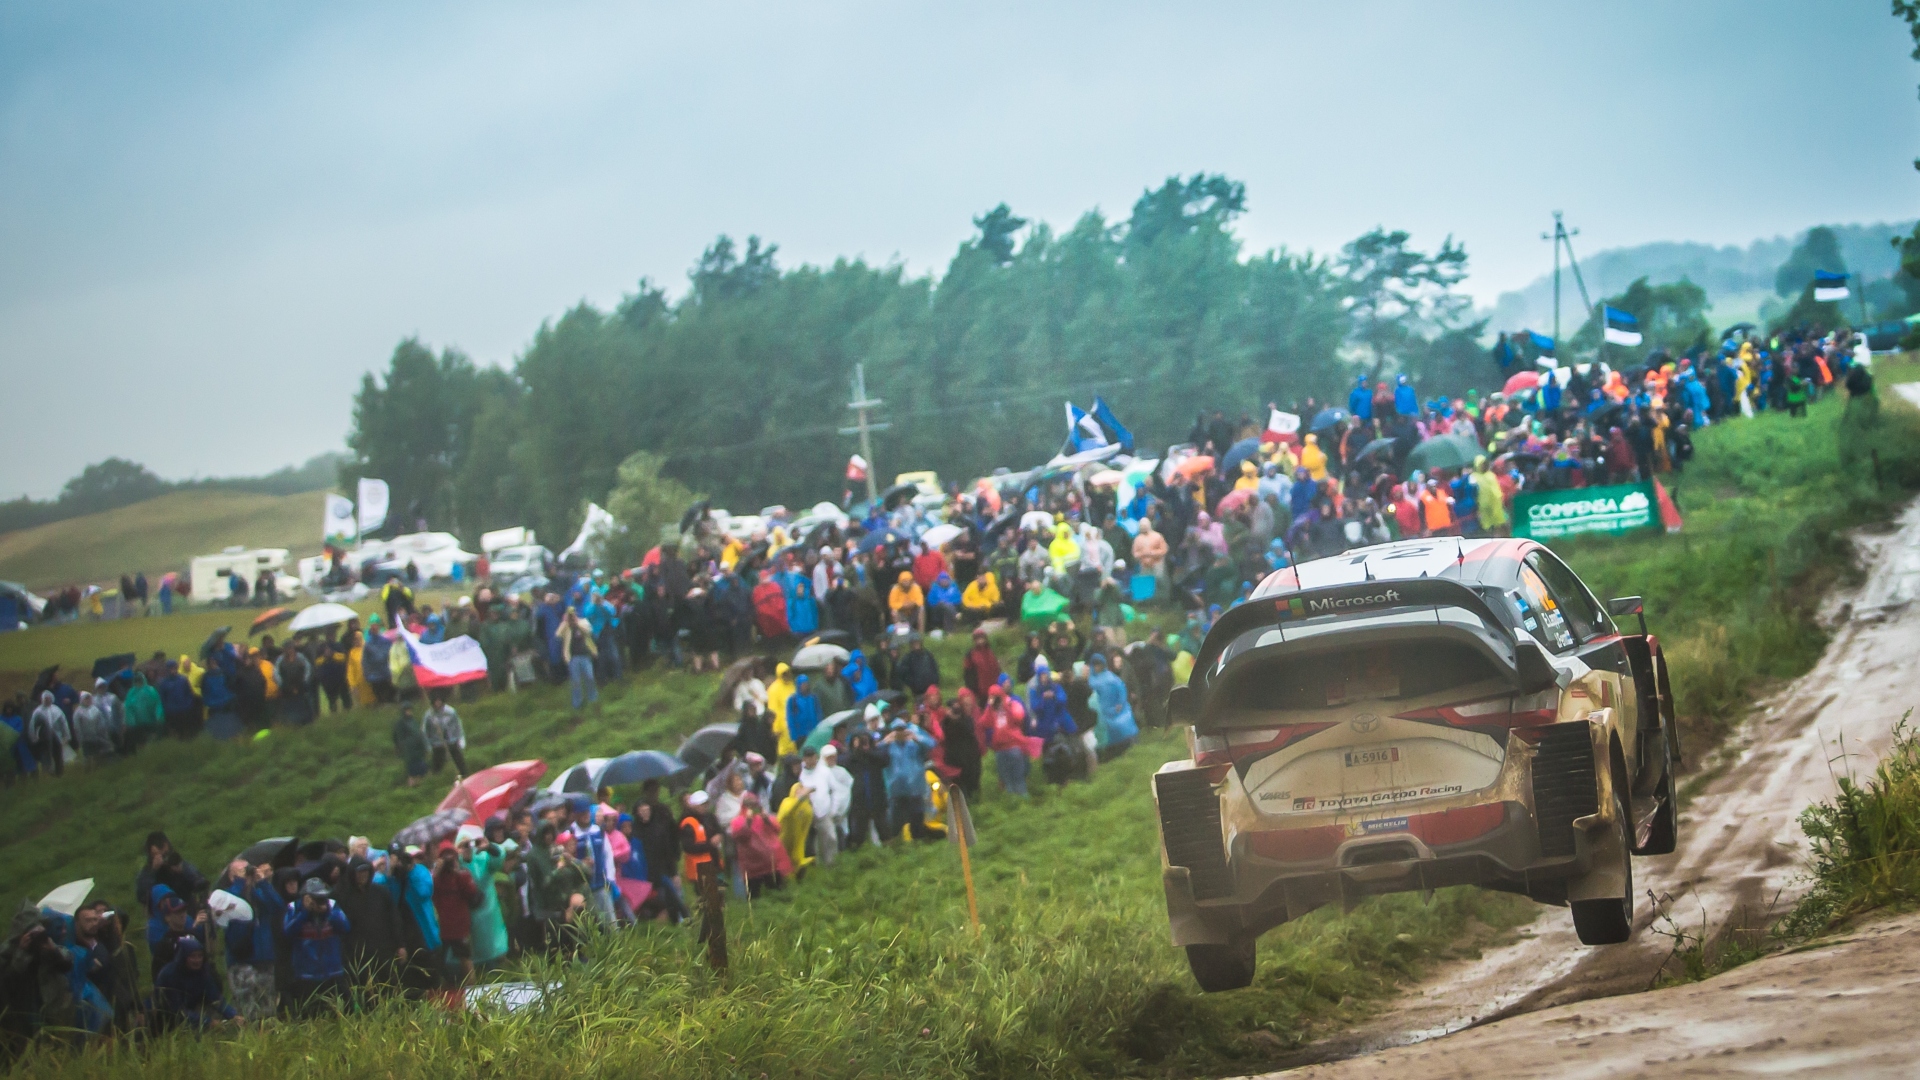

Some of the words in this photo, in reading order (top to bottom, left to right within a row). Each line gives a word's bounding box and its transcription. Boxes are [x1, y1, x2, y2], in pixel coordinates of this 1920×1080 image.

[1528, 498, 1618, 520] COMPENSA
[1339, 547, 1434, 566] 12
[1309, 589, 1401, 612] Microsoft
[1319, 796, 1368, 808] TOYOTA
[1372, 790, 1417, 801] GAZOO
[1420, 784, 1463, 796] Racing
[1367, 819, 1407, 829] MICHELIN
